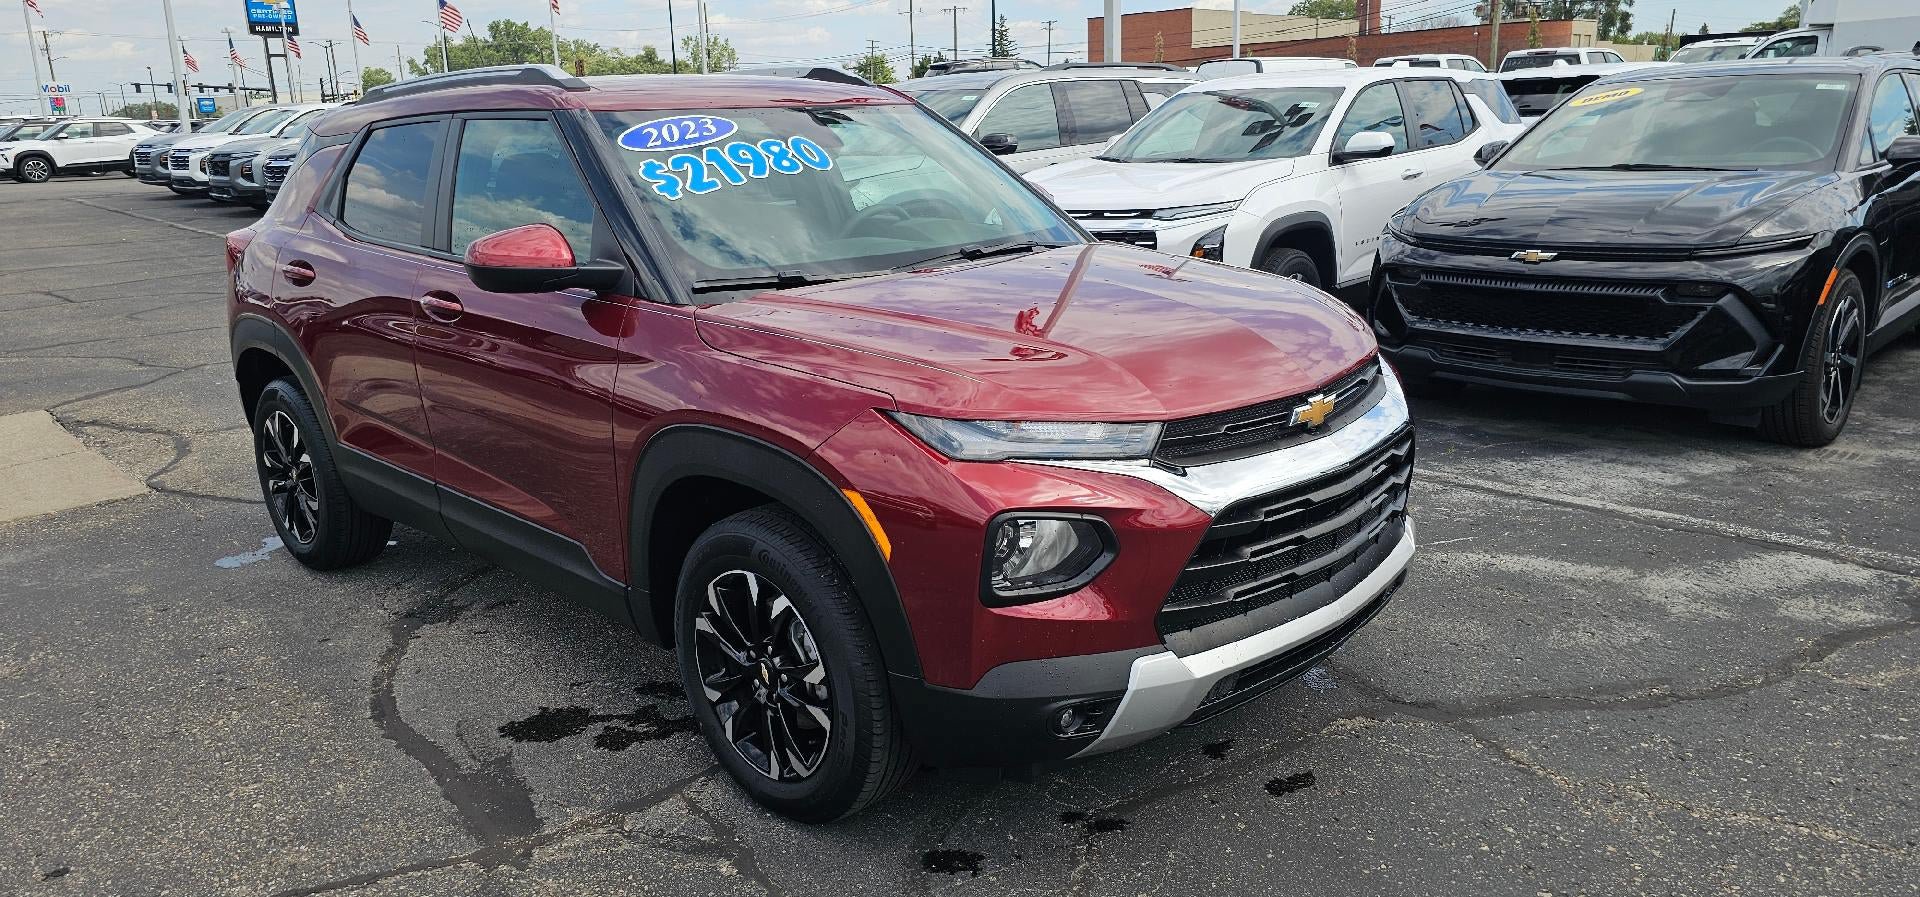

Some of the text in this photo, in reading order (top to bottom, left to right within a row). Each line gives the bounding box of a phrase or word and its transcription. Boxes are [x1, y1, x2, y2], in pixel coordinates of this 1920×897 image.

[41, 84, 71, 93] Mobil
[641, 118, 717, 148] 2023
[638, 135, 834, 200] $21980
